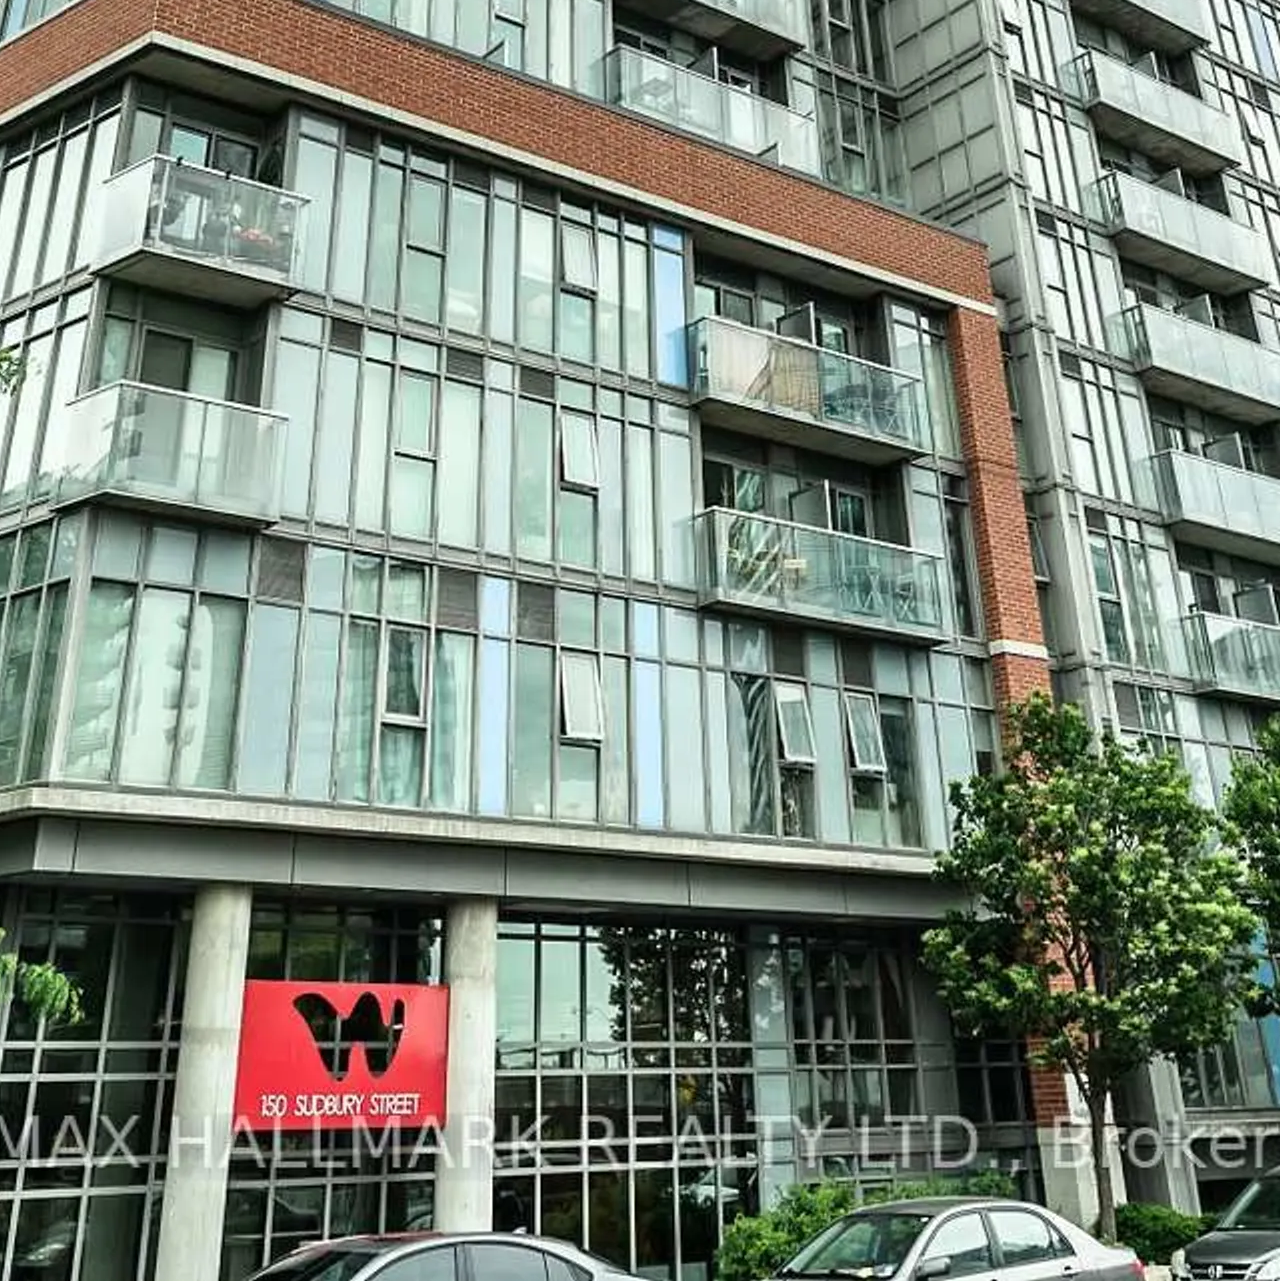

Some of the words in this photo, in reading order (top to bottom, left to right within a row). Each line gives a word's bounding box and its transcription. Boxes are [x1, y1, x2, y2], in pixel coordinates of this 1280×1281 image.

[261, 1094, 288, 1117] 150
[294, 1094, 365, 1116] SUDBURY
[369, 1093, 420, 1115] STREET
